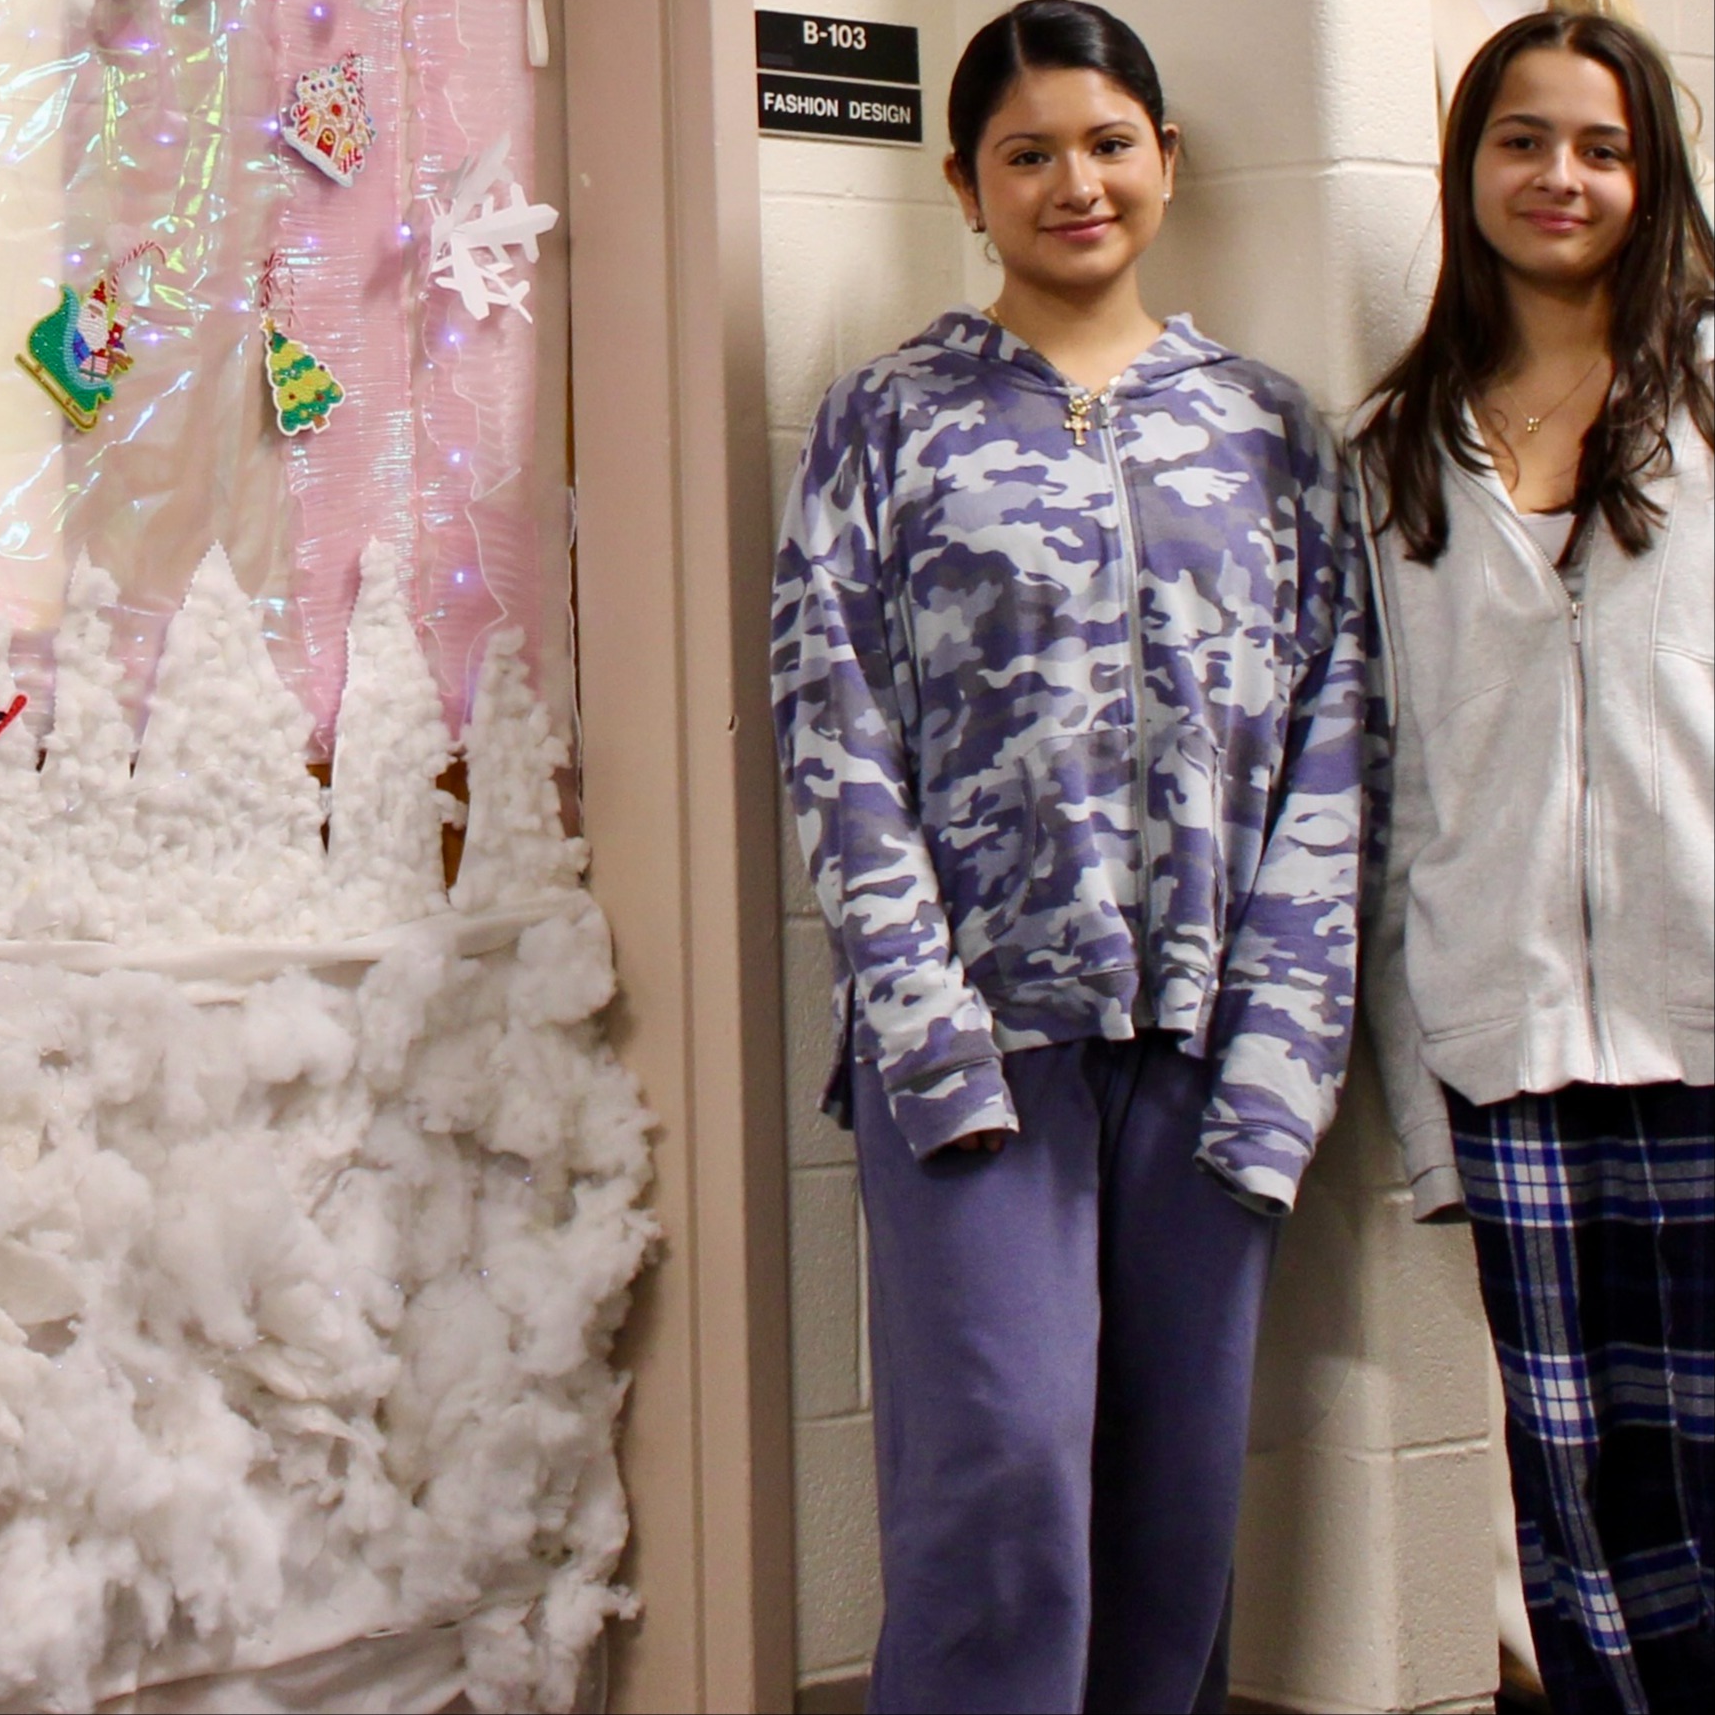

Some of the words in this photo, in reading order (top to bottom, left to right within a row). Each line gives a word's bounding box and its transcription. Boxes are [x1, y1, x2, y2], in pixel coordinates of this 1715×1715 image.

[802, 20, 867, 50] B-103
[763, 92, 839, 118] FASHION
[848, 100, 912, 125] DESIGN
